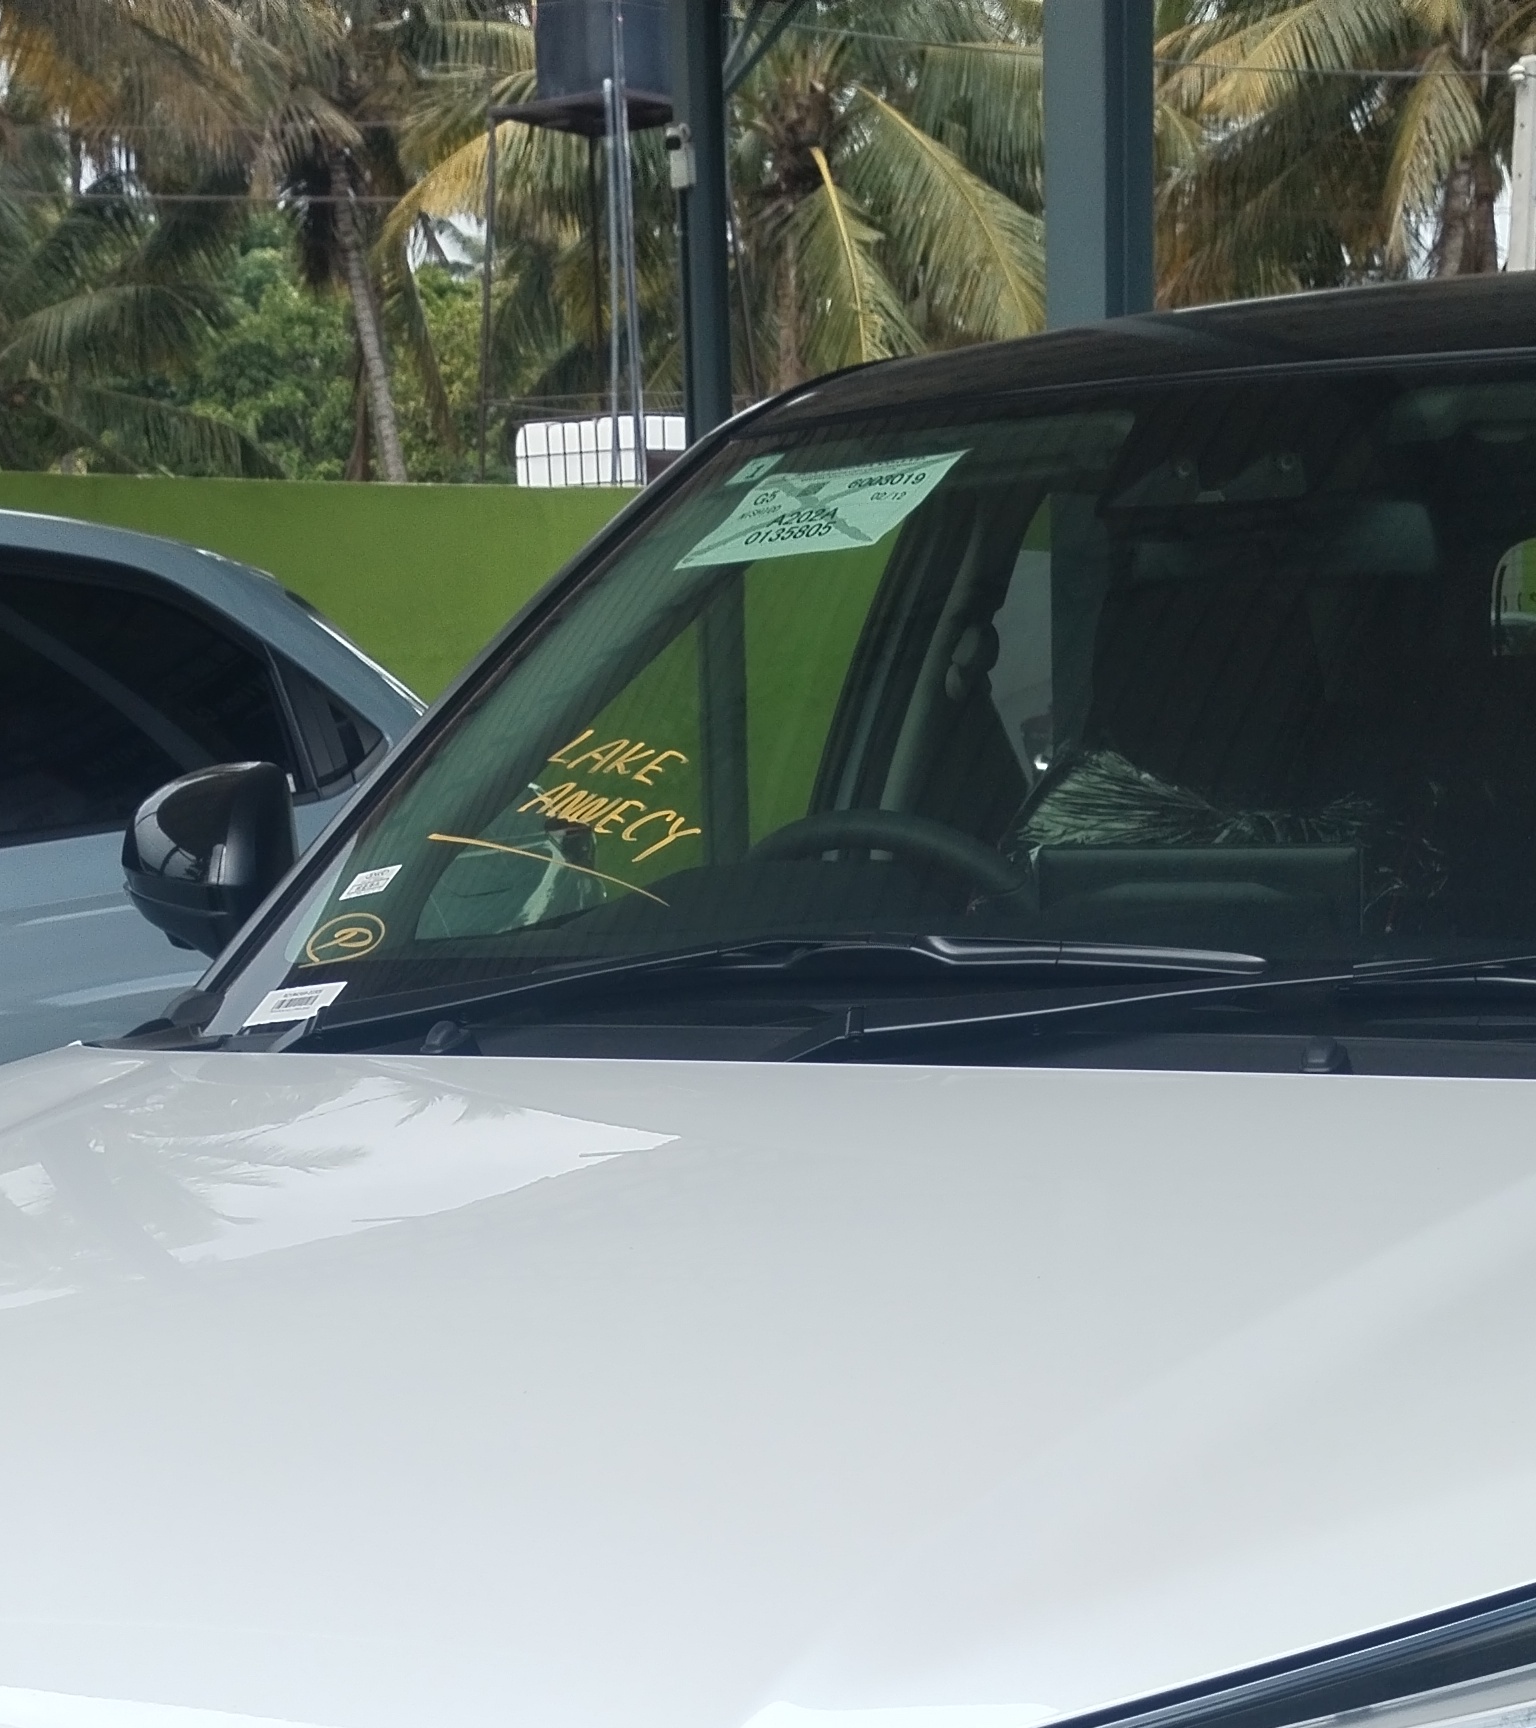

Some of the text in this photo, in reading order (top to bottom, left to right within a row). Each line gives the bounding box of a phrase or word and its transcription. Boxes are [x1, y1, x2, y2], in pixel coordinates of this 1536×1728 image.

[743, 521, 838, 546] 0135805
[547, 729, 690, 787] LAKE
[516, 782, 702, 863] ANNECY
